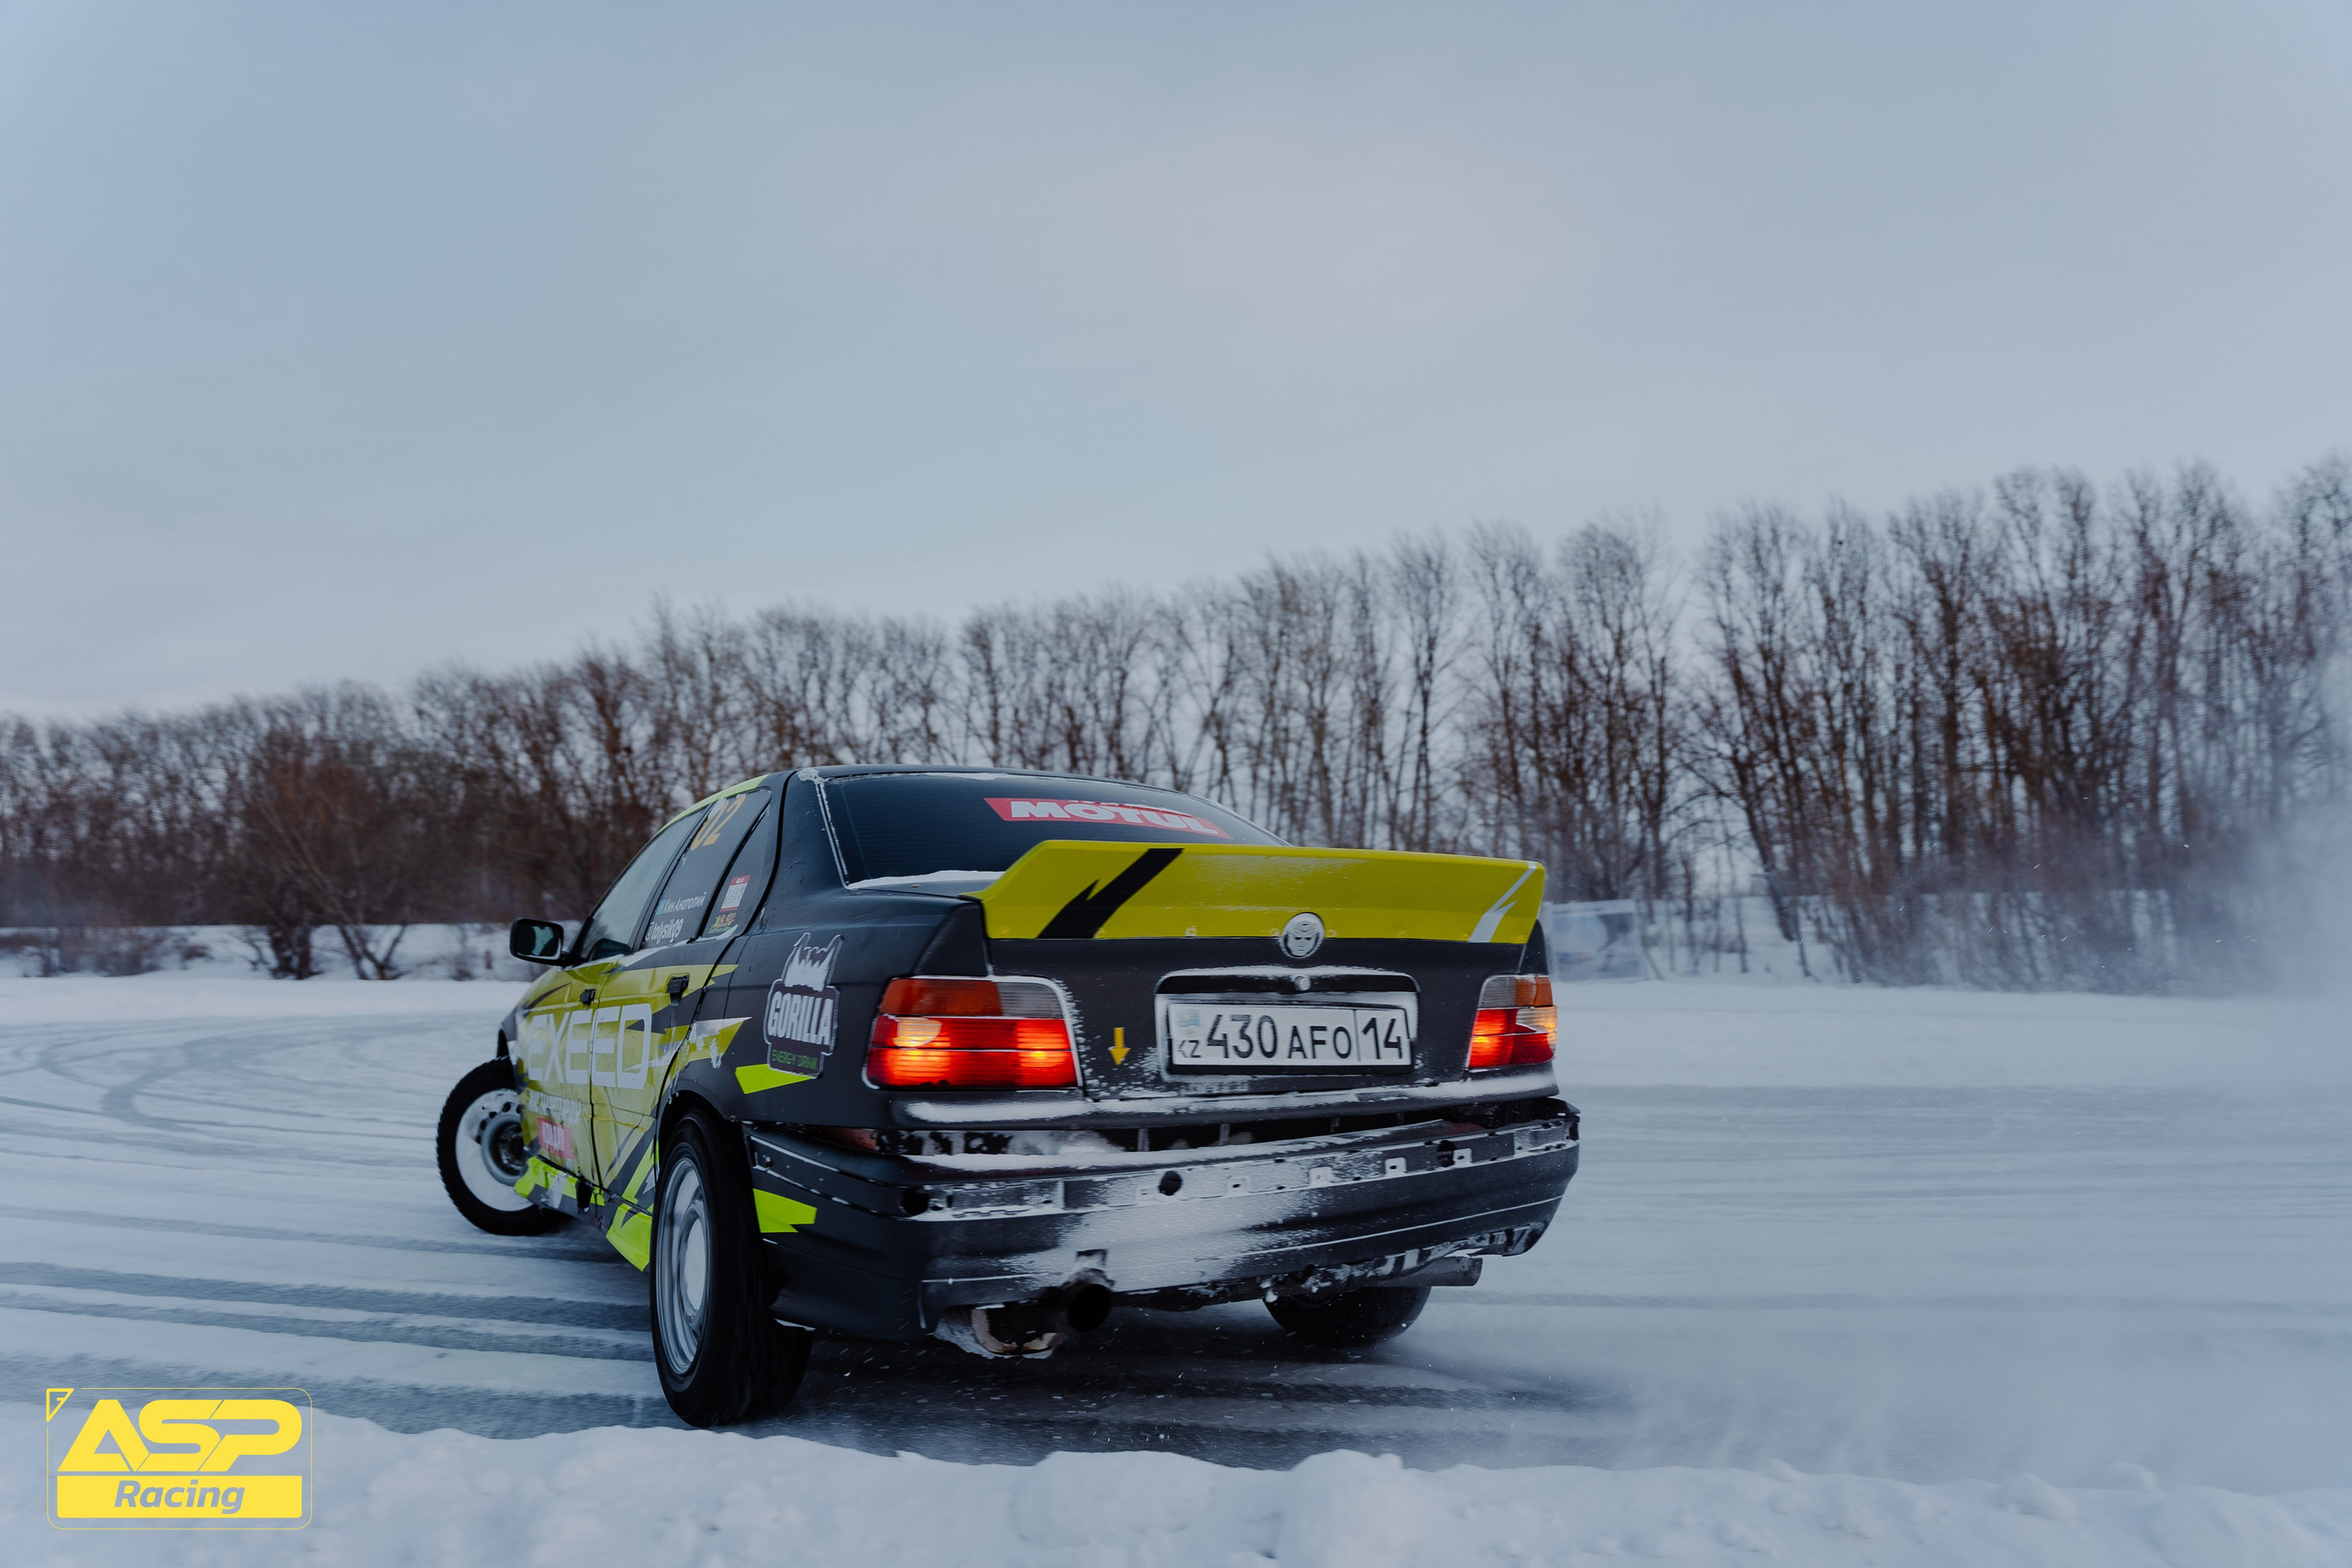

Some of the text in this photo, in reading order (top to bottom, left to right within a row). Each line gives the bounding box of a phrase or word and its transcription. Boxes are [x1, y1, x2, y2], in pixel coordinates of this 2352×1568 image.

[1011, 801, 1218, 835] MOTUL
[767, 991, 834, 1045] GORILLA
[1206, 1014, 1278, 1058] 430
[1288, 1025, 1351, 1059] AFO
[1362, 1017, 1403, 1059] 14
[527, 1003, 652, 1090] EXEED
[772, 1049, 797, 1065] ENERGY
